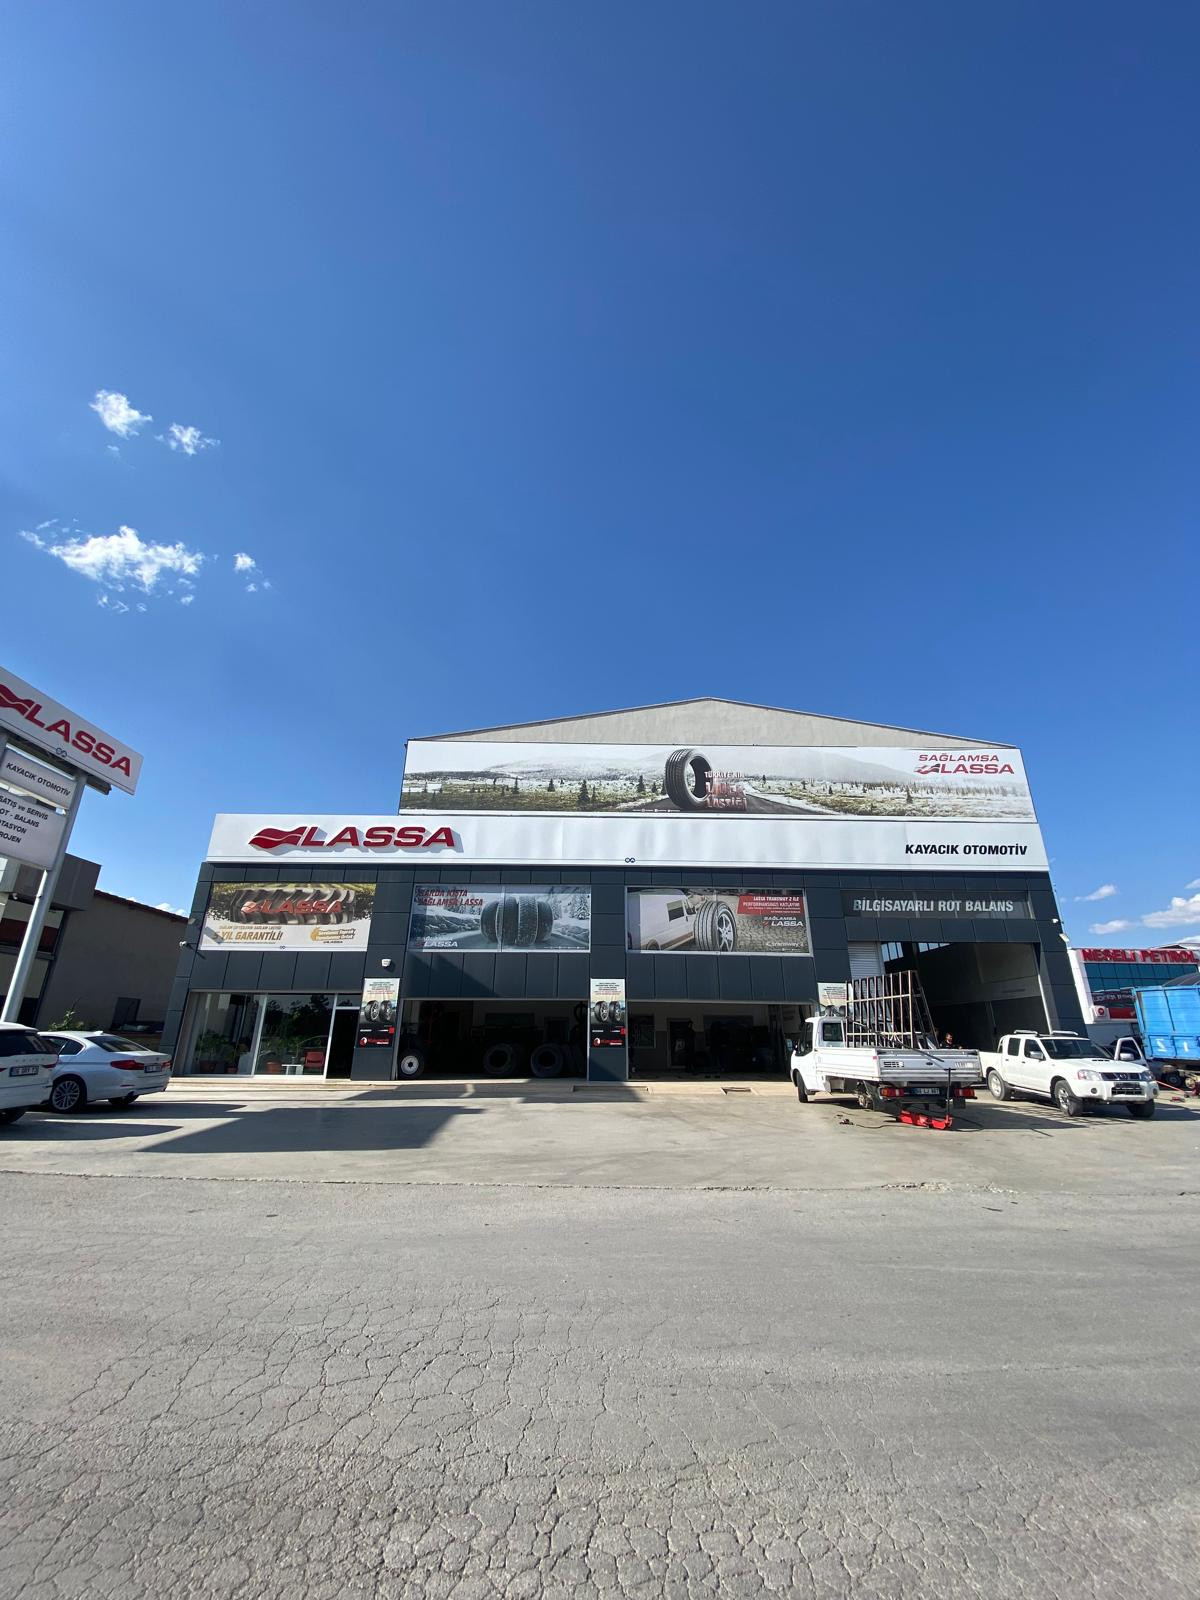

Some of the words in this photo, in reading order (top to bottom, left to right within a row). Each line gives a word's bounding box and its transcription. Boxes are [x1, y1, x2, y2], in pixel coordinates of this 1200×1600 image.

[25, 703, 131, 777] LASSA
[919, 752, 1000, 762] SAĞLAMSA
[6, 762, 38, 781] KAYACIK
[940, 763, 1015, 775] LASSA
[0, 820, 27, 834] TASYON
[14, 813, 40, 828] BALANS
[299, 826, 456, 847] LASSA
[905, 844, 960, 855] KAYACIK
[963, 843, 1028, 856] OTOMOTİV
[259, 900, 342, 914] LASSA
[853, 898, 934, 912] BİLGİSAYARLI
[938, 900, 962, 912] ROT
[965, 900, 1014, 912] BALANS
